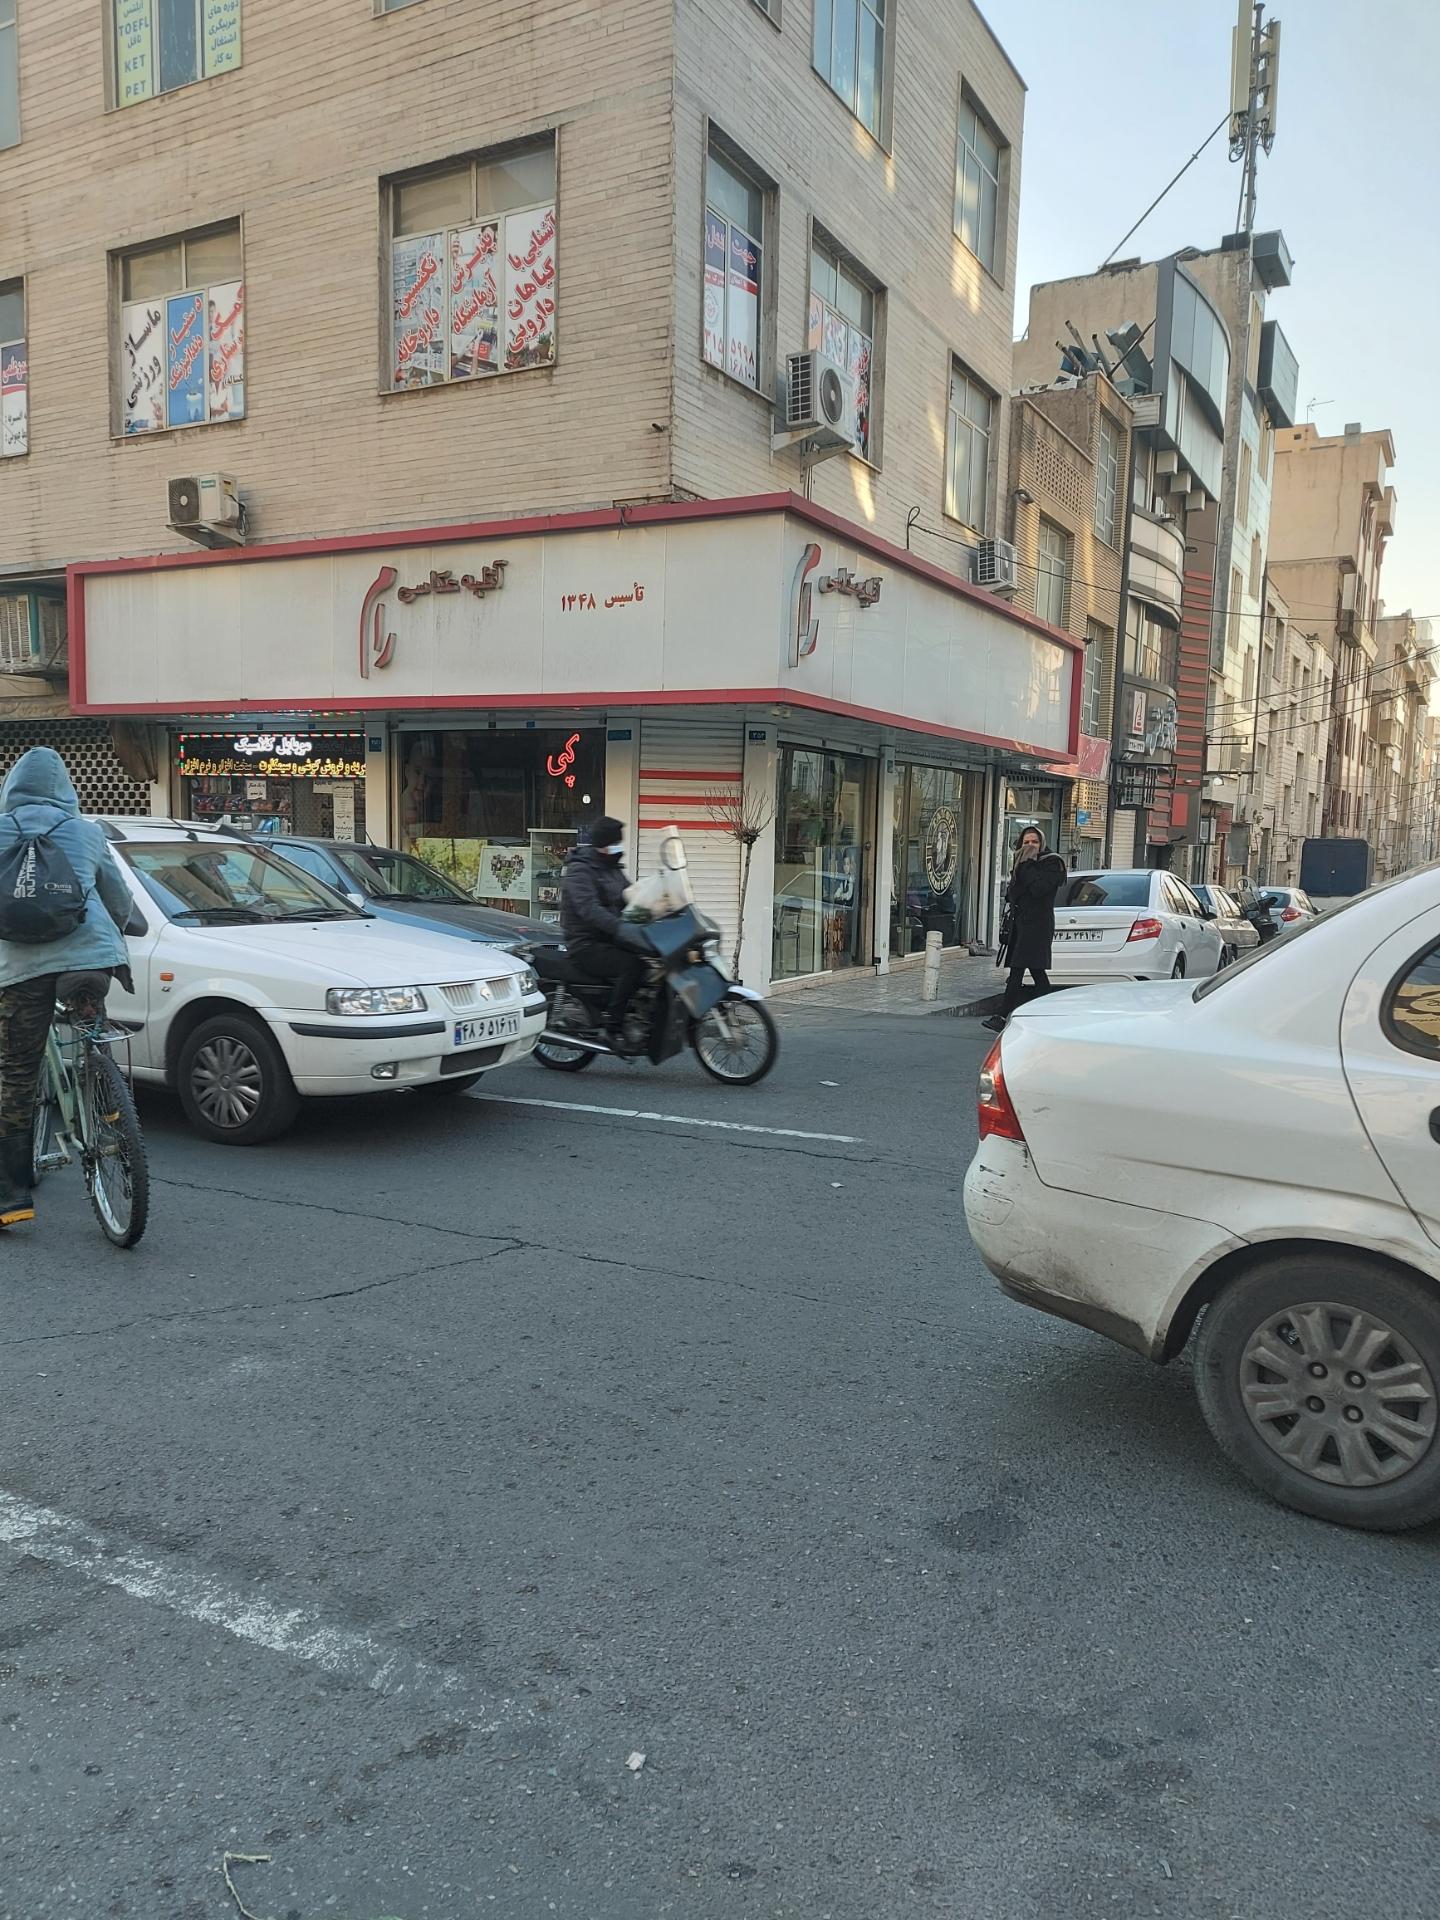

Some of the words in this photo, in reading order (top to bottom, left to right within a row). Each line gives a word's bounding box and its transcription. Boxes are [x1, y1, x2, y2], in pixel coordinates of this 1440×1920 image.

[208, 5, 222, 20] های
[118, 16, 150, 37] TOEFL
[208, 17, 237, 36] مربیگری
[210, 32, 237, 51] اشتغال
[124, 54, 146, 73] KET
[213, 54, 225, 67] کار
[224, 52, 233, 63] به
[125, 79, 147, 98] PET
[451, 269, 498, 336] آزمایشگاه
[123, 307, 162, 369] ماساژ
[126, 354, 162, 410] ورزشی
[397, 569, 461, 605] عکاسی
[460, 558, 510, 599] آتلیه
[560, 592, 597, 612] ۱۳۴۸
[233, 736, 276, 756] کلاسیک
[274, 736, 313, 757] موبایل
[462, 1021, 476, 1041] ۴۸
[487, 1017, 506, 1036] ۵۱۶
[508, 1018, 518, 1034] ۱۱
